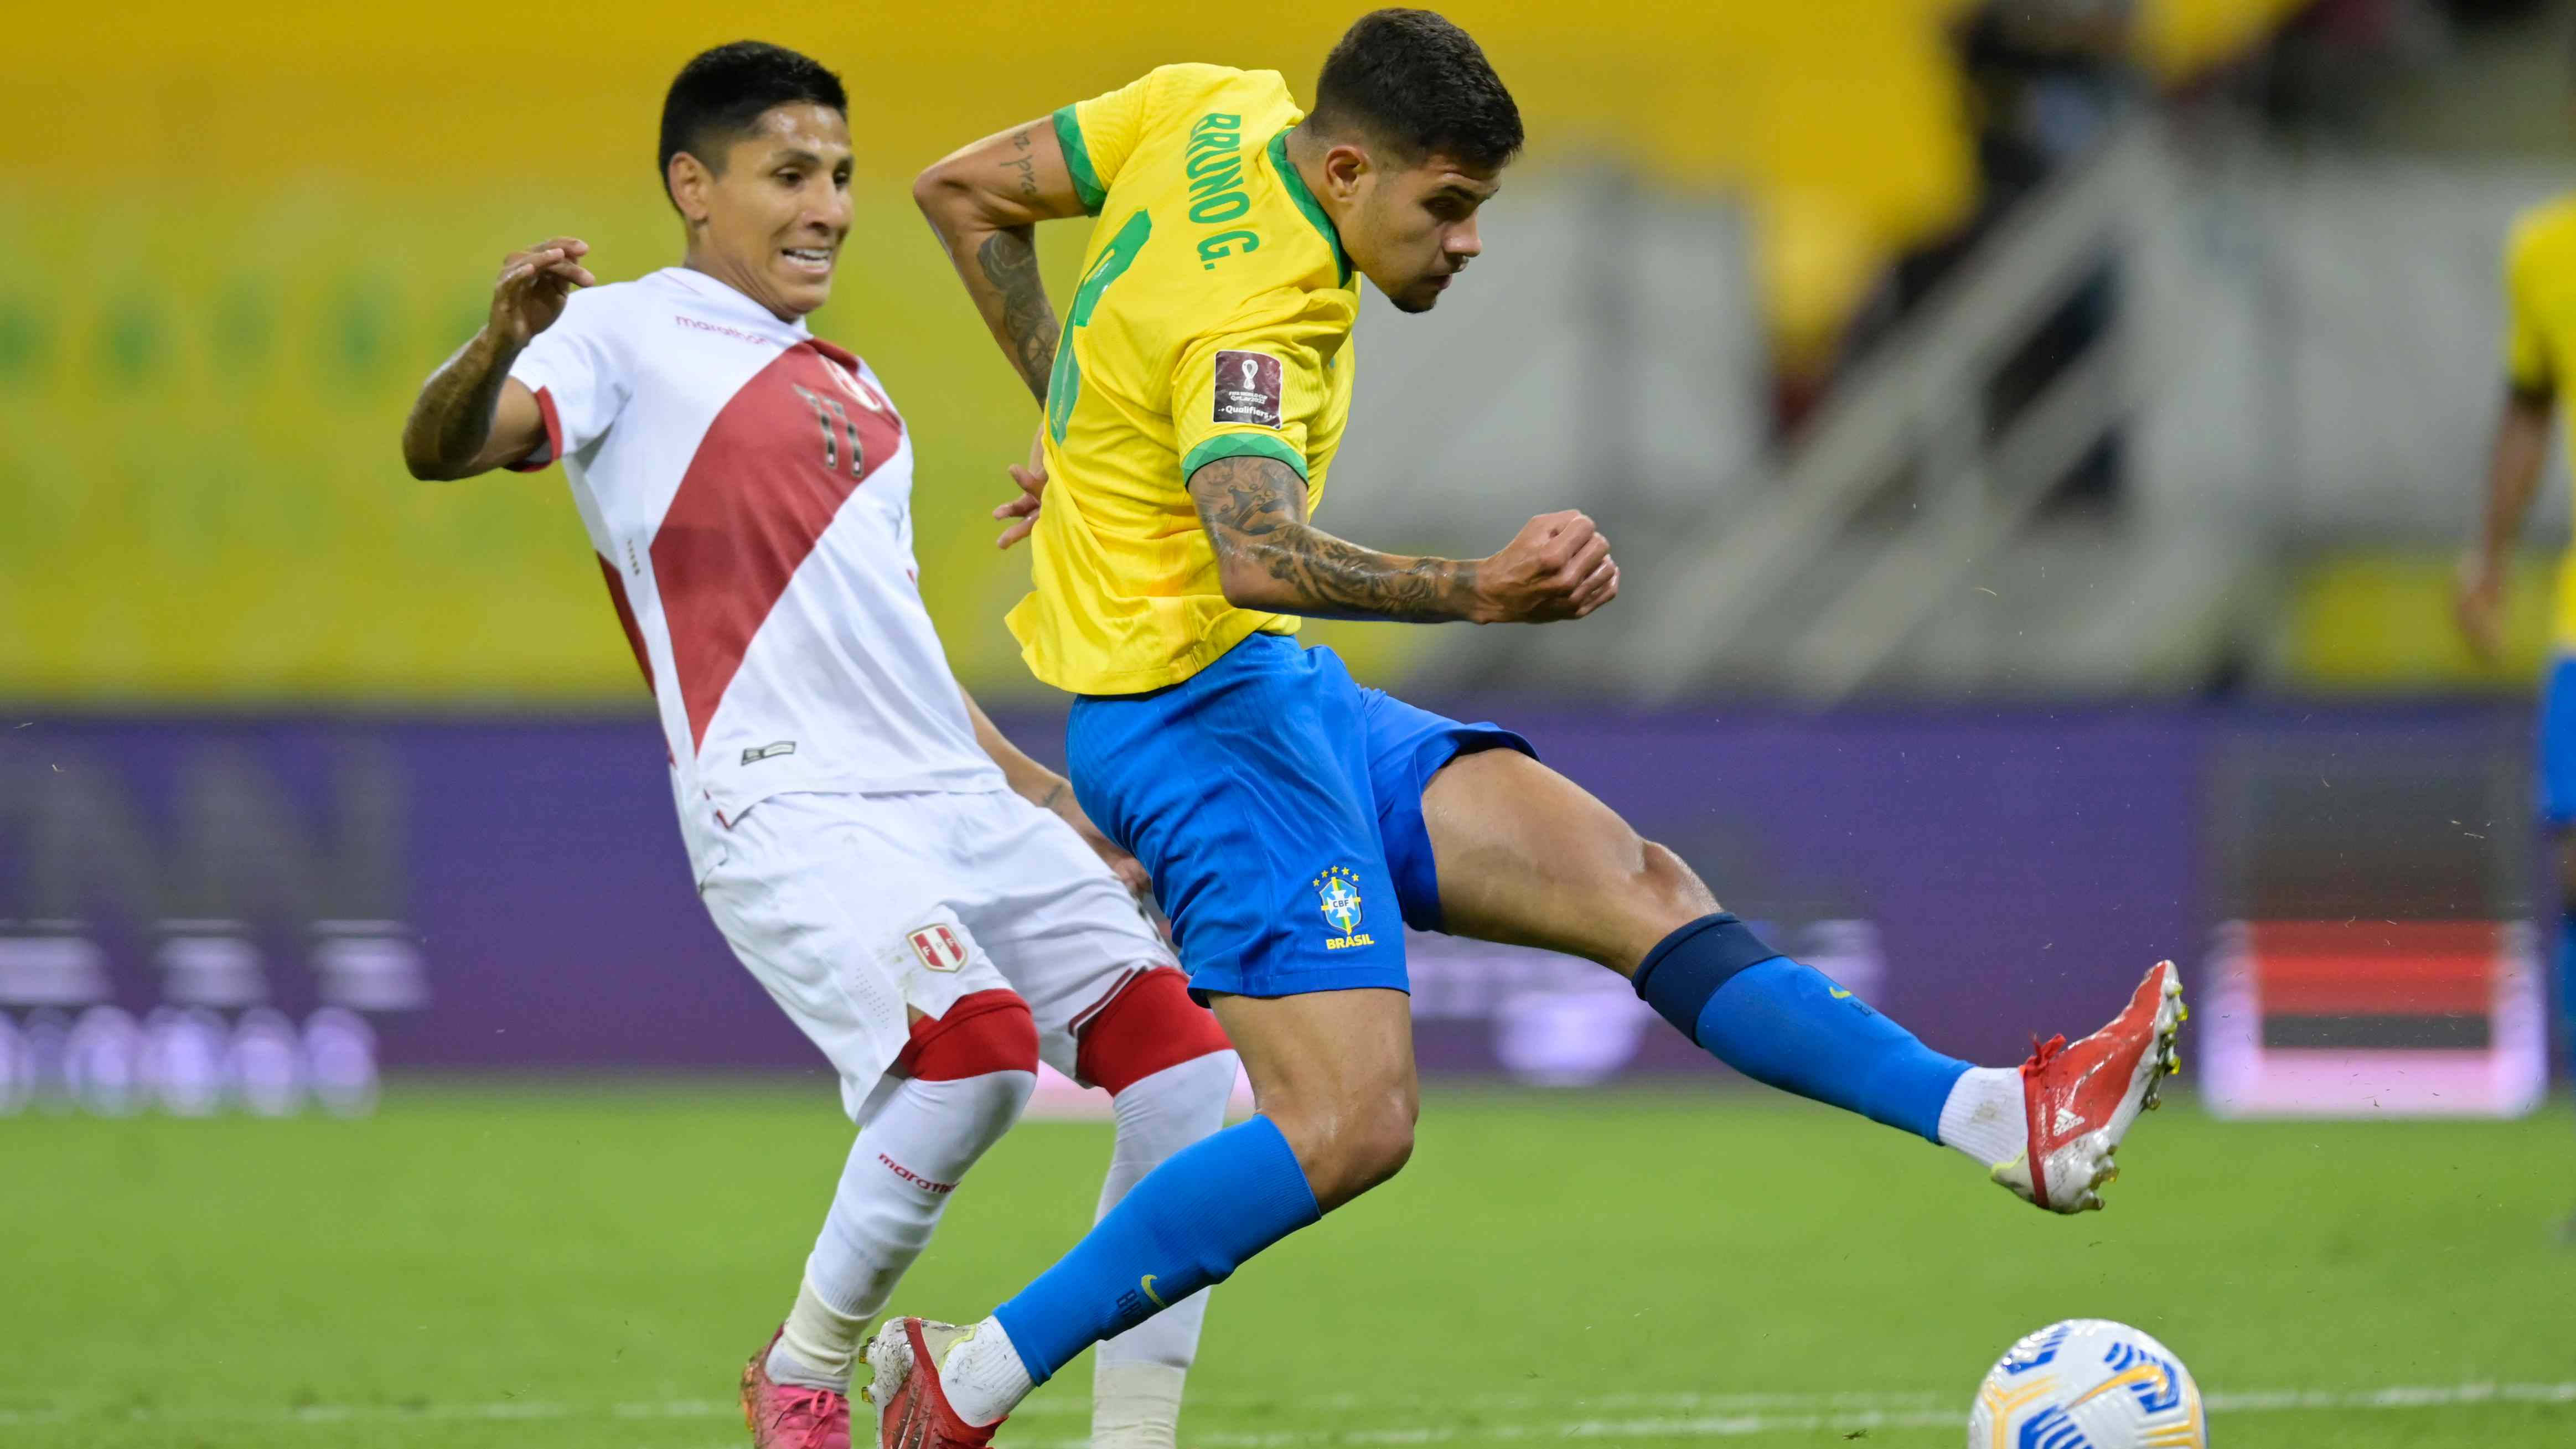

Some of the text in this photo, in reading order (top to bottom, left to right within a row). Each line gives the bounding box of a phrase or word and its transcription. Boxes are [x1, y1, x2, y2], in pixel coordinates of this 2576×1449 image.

[1185, 112, 1250, 224] BRUNO
[1225, 406, 1269, 418] Qualifiers
[792, 381, 863, 478] 11
[1333, 899, 1349, 908] CBF
[1326, 934, 1374, 949] BRASIL
